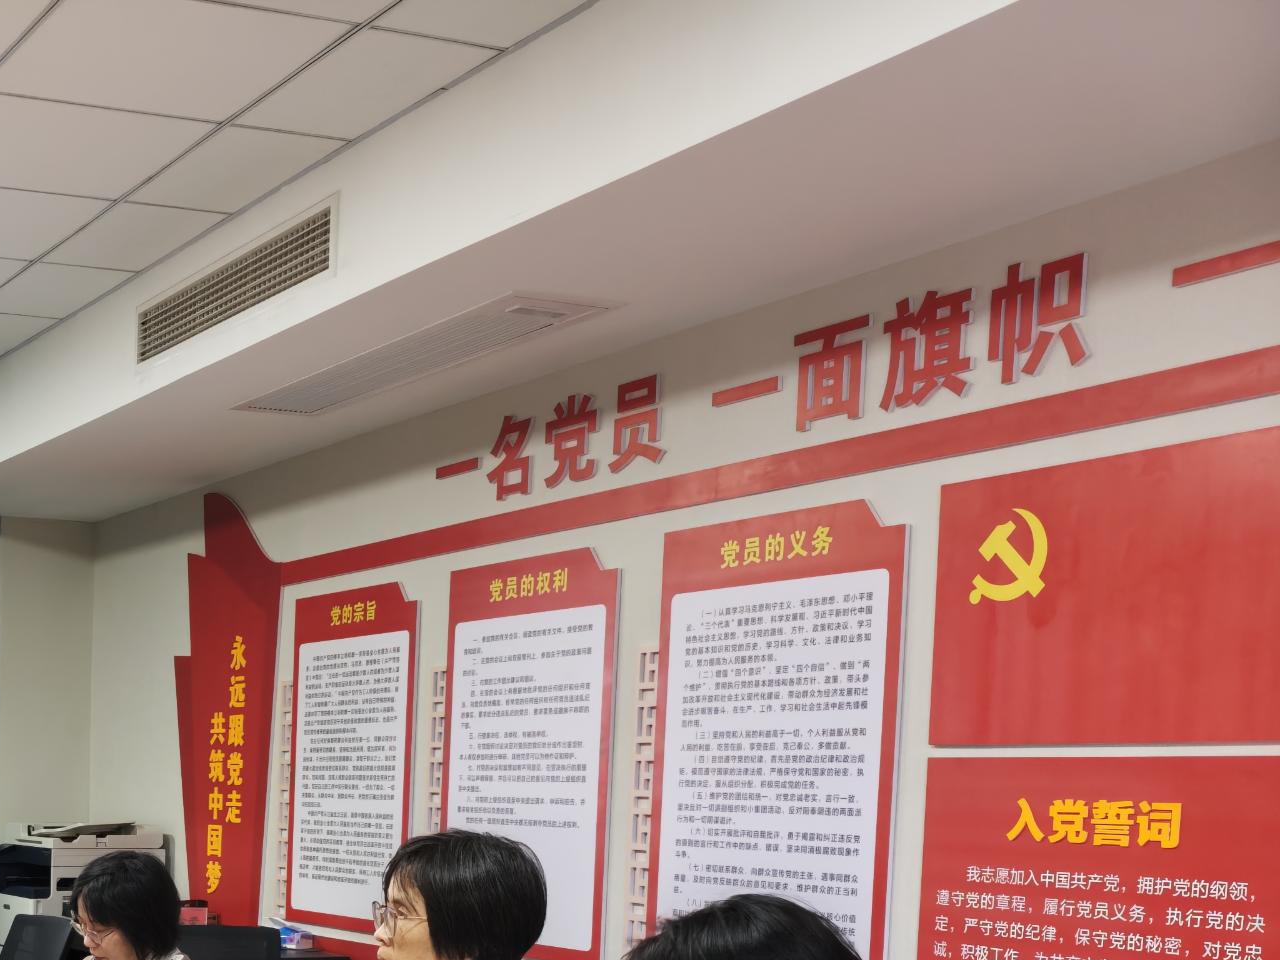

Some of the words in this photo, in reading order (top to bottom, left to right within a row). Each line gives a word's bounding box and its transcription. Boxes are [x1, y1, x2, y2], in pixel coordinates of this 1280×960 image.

[435, 373, 669, 502] 一名党员
[712, 252, 1089, 433] 一面旗帜
[721, 526, 833, 569] 党员的义务
[489, 568, 568, 602] 党员的权利
[330, 600, 377, 626] 党的宗旨
[225, 635, 247, 824] 永远跟党走
[206, 712, 226, 894] 共筑中国梦
[1006, 798, 1182, 849] 入党誓词
